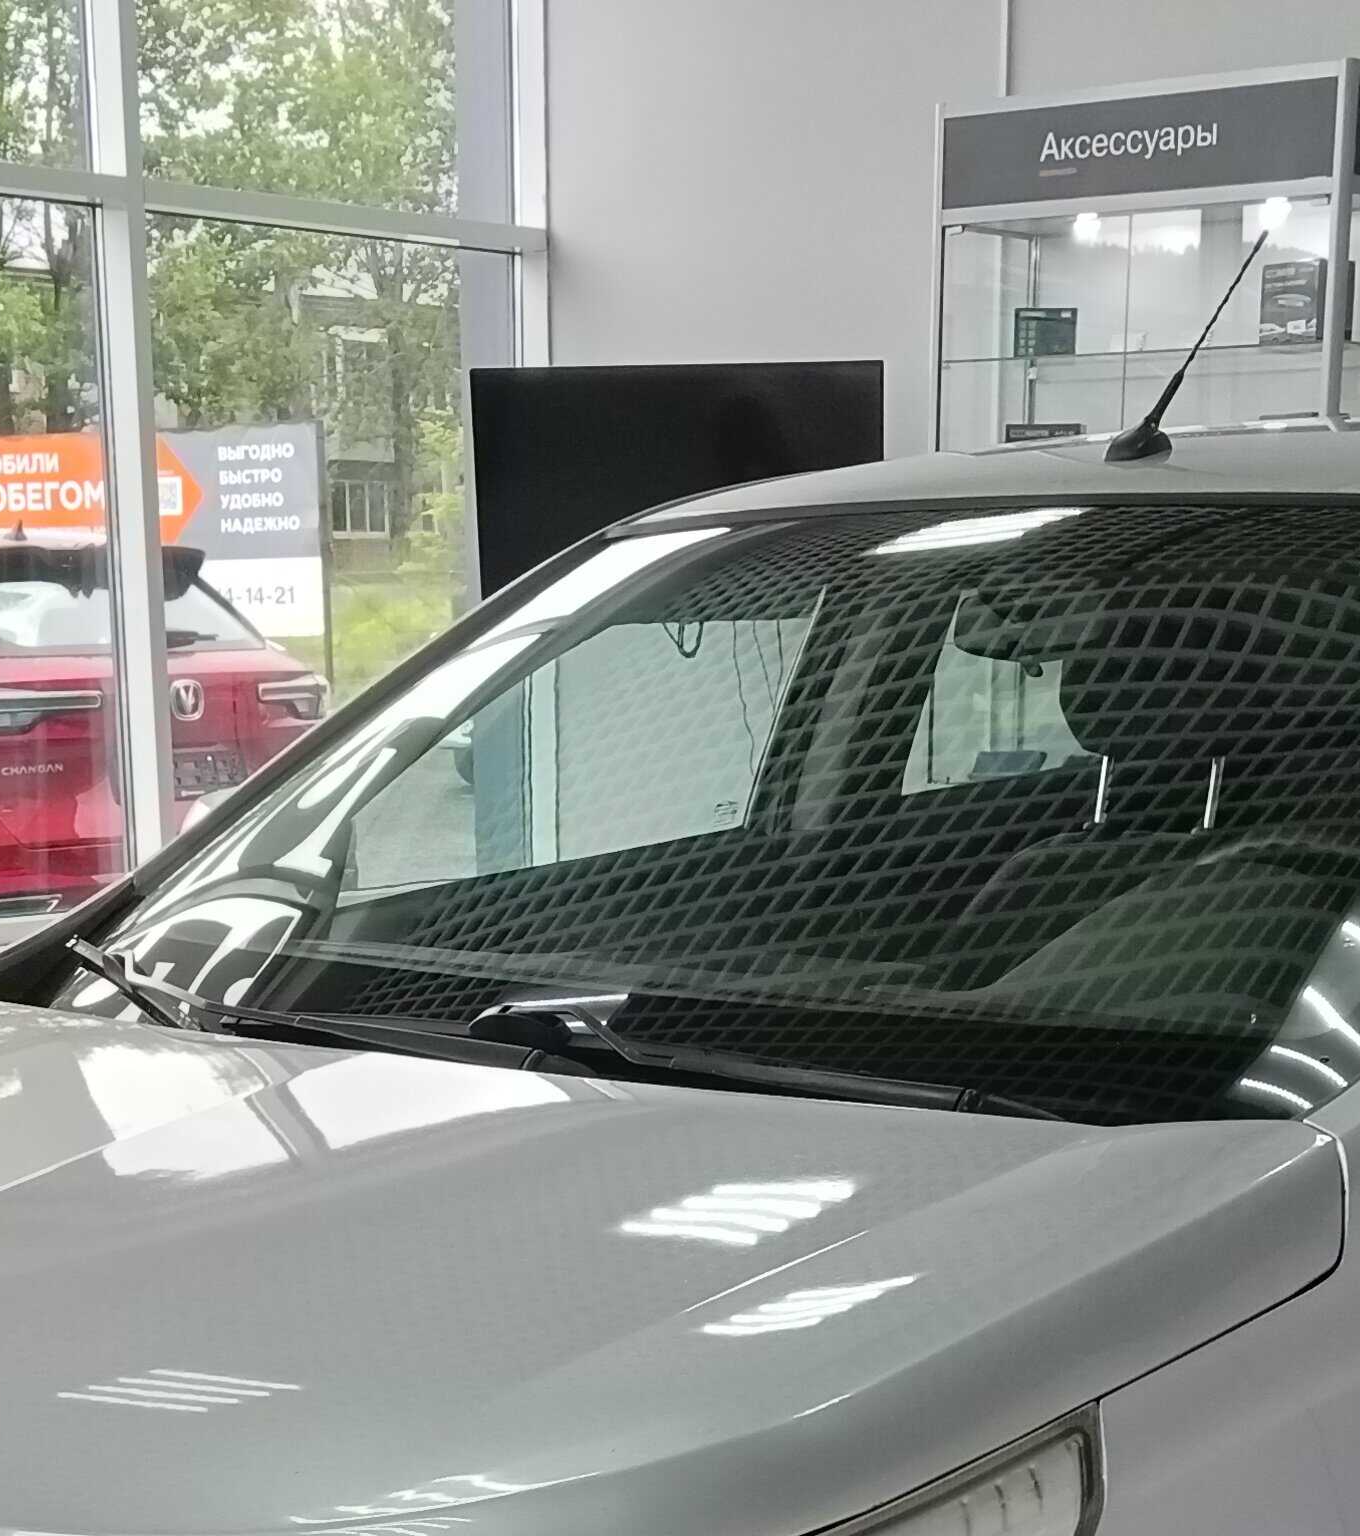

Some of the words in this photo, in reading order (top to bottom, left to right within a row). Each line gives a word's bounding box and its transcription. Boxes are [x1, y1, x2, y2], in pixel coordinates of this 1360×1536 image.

[1039, 123, 1218, 162] Аксессуары
[217, 442, 295, 462] ВЫГОДНО
[218, 467, 283, 486] БЫСТРО
[220, 491, 284, 511] УДОБНО
[220, 515, 301, 535] НАДЕЖНО
[1, 763, 64, 776] CHANGAN
